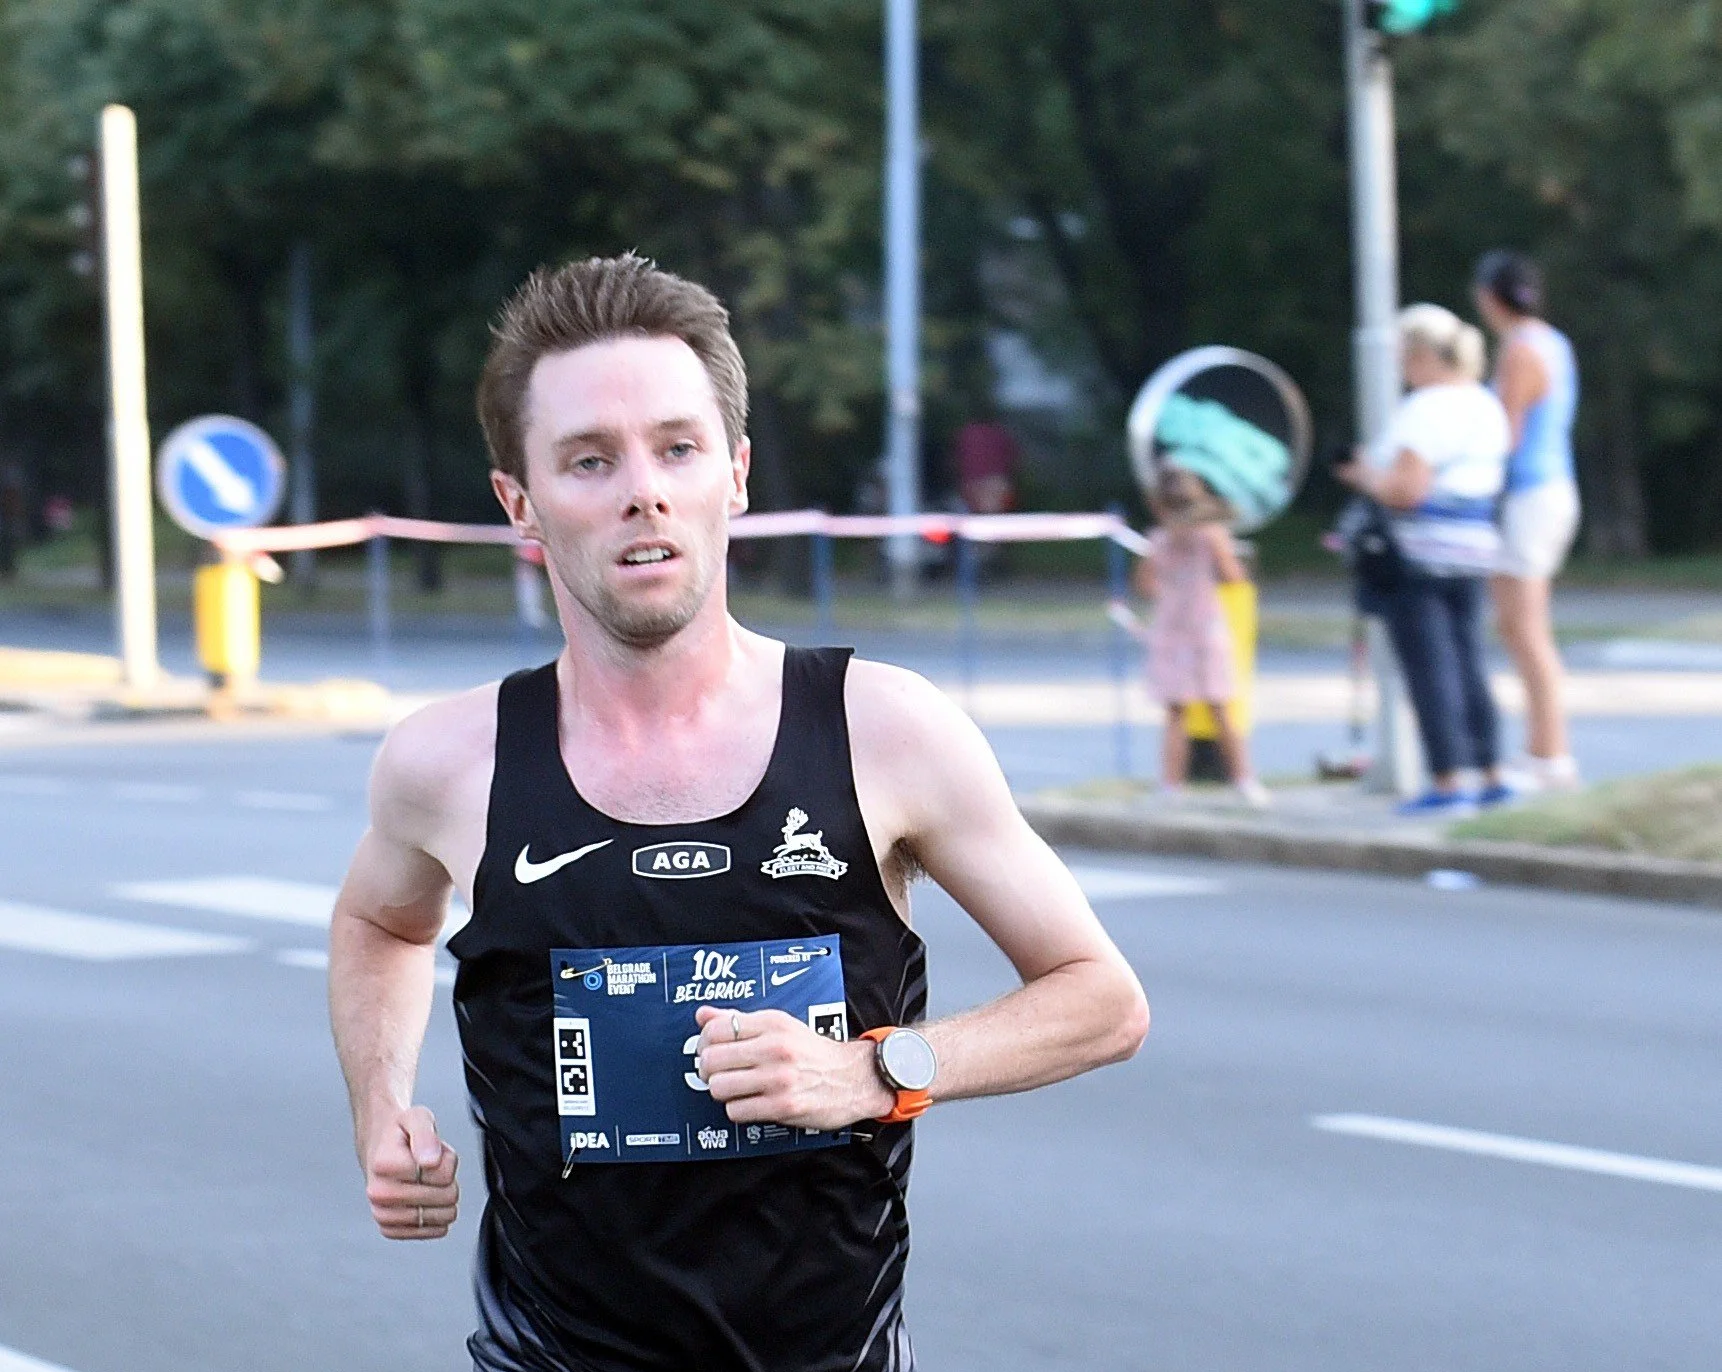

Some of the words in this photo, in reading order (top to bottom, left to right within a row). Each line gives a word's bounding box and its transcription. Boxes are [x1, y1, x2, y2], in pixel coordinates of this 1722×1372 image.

[652, 850, 711, 870] AGA
[606, 962, 651, 974] BELGRADE
[691, 949, 739, 981] 10K
[607, 972, 657, 985] MARATHON
[607, 983, 636, 996] EVENT
[673, 979, 757, 1003] BELGRADE
